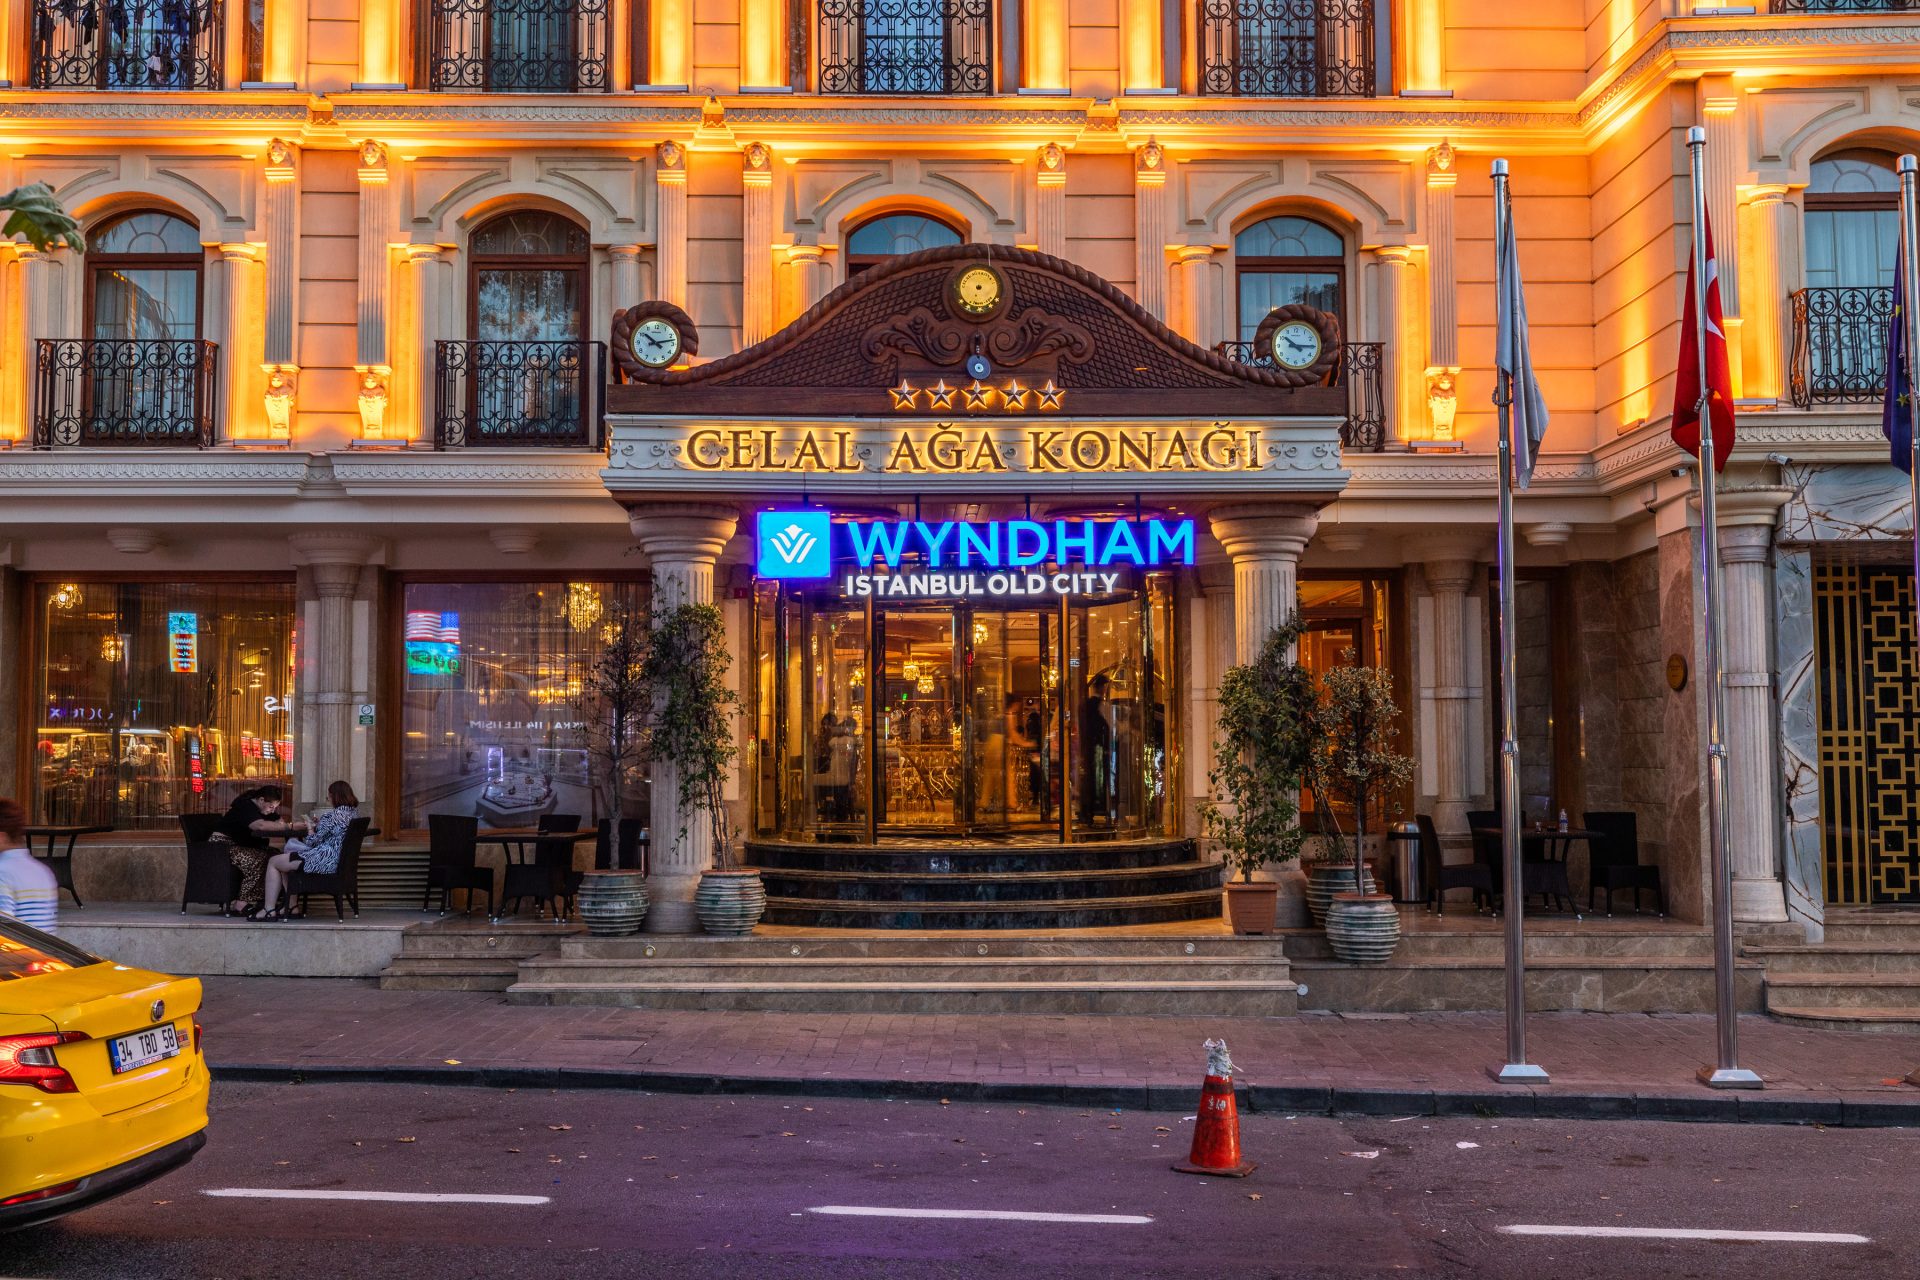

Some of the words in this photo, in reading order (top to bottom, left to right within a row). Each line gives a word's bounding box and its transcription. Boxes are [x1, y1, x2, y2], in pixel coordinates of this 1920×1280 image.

[686, 429, 862, 471] CELAL
[885, 422, 1007, 471] AĞA
[1028, 421, 1263, 470] KONAĞI
[847, 519, 1195, 568] WYNDHAM
[847, 574, 984, 596] ISTANBUL
[987, 573, 1047, 595] OLD
[1052, 573, 1119, 594] CITY
[118, 1040, 132, 1062] 34
[138, 1032, 158, 1056] TBD
[162, 1028, 175, 1049] 58
